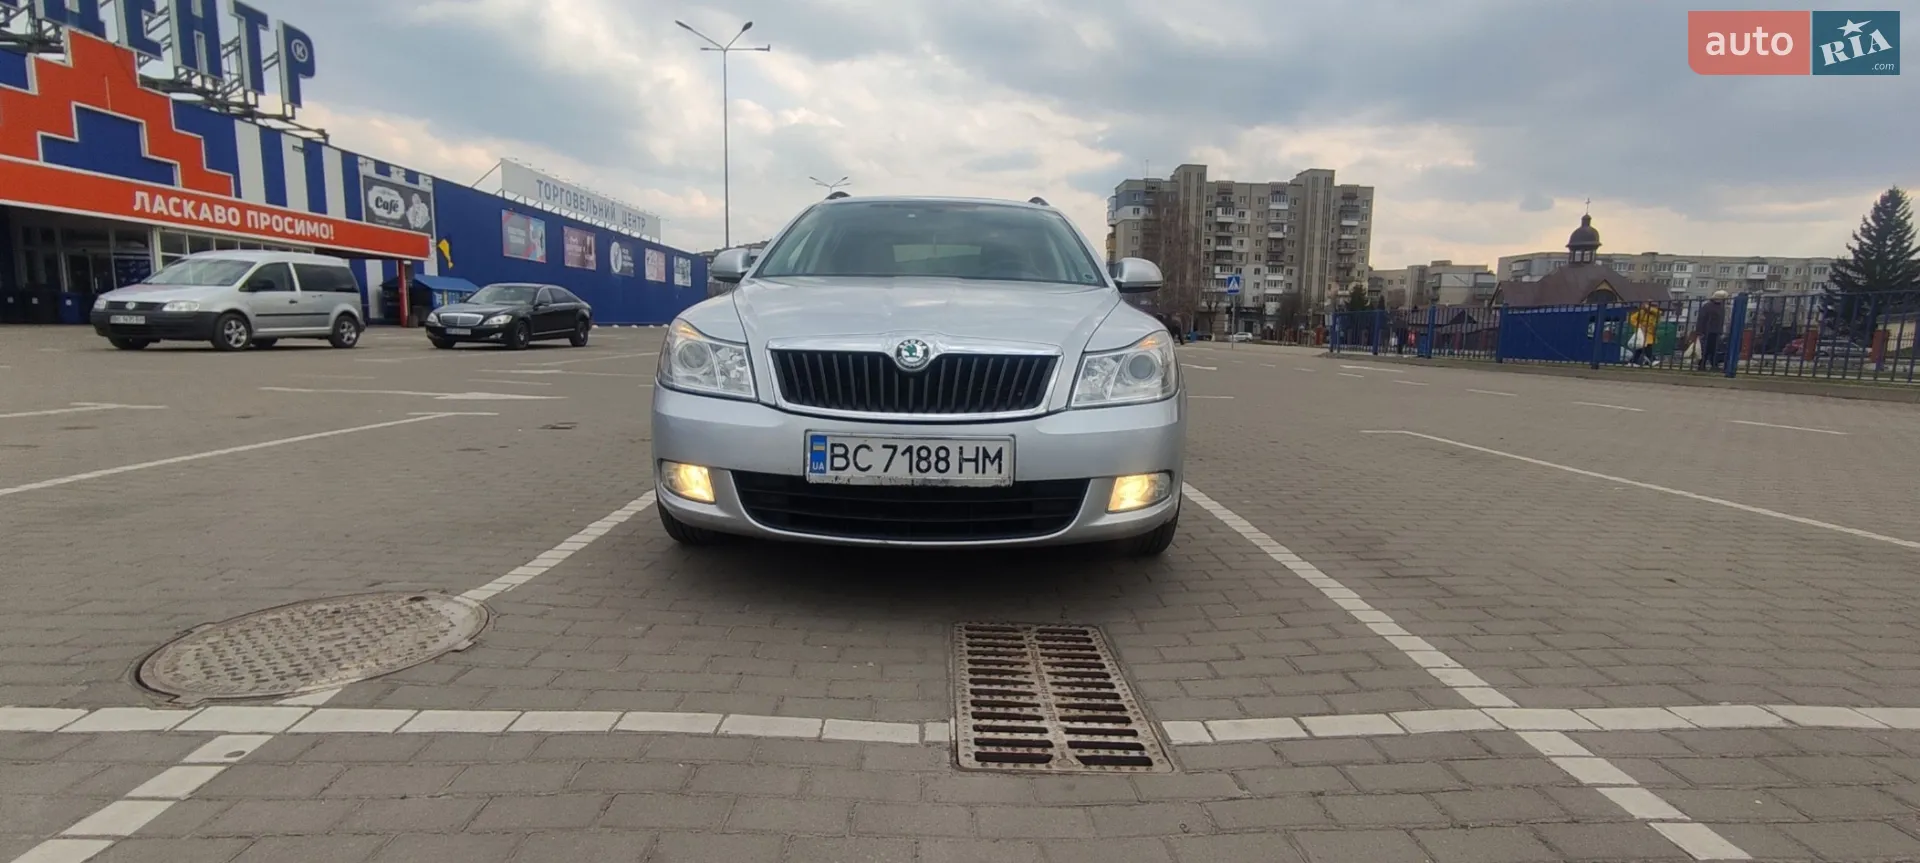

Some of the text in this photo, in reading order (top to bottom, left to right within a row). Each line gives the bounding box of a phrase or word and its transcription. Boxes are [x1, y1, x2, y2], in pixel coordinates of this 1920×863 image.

[133, 190, 334, 240] ЛАСКАВО ПРОСИМО!
[375, 196, 399, 215] Café
[536, 179, 646, 232] ТОРГОВЕЛЬНИЙ ЦЕНТР
[812, 462, 825, 471] UA
[829, 443, 1003, 475] BC 7188 HM
